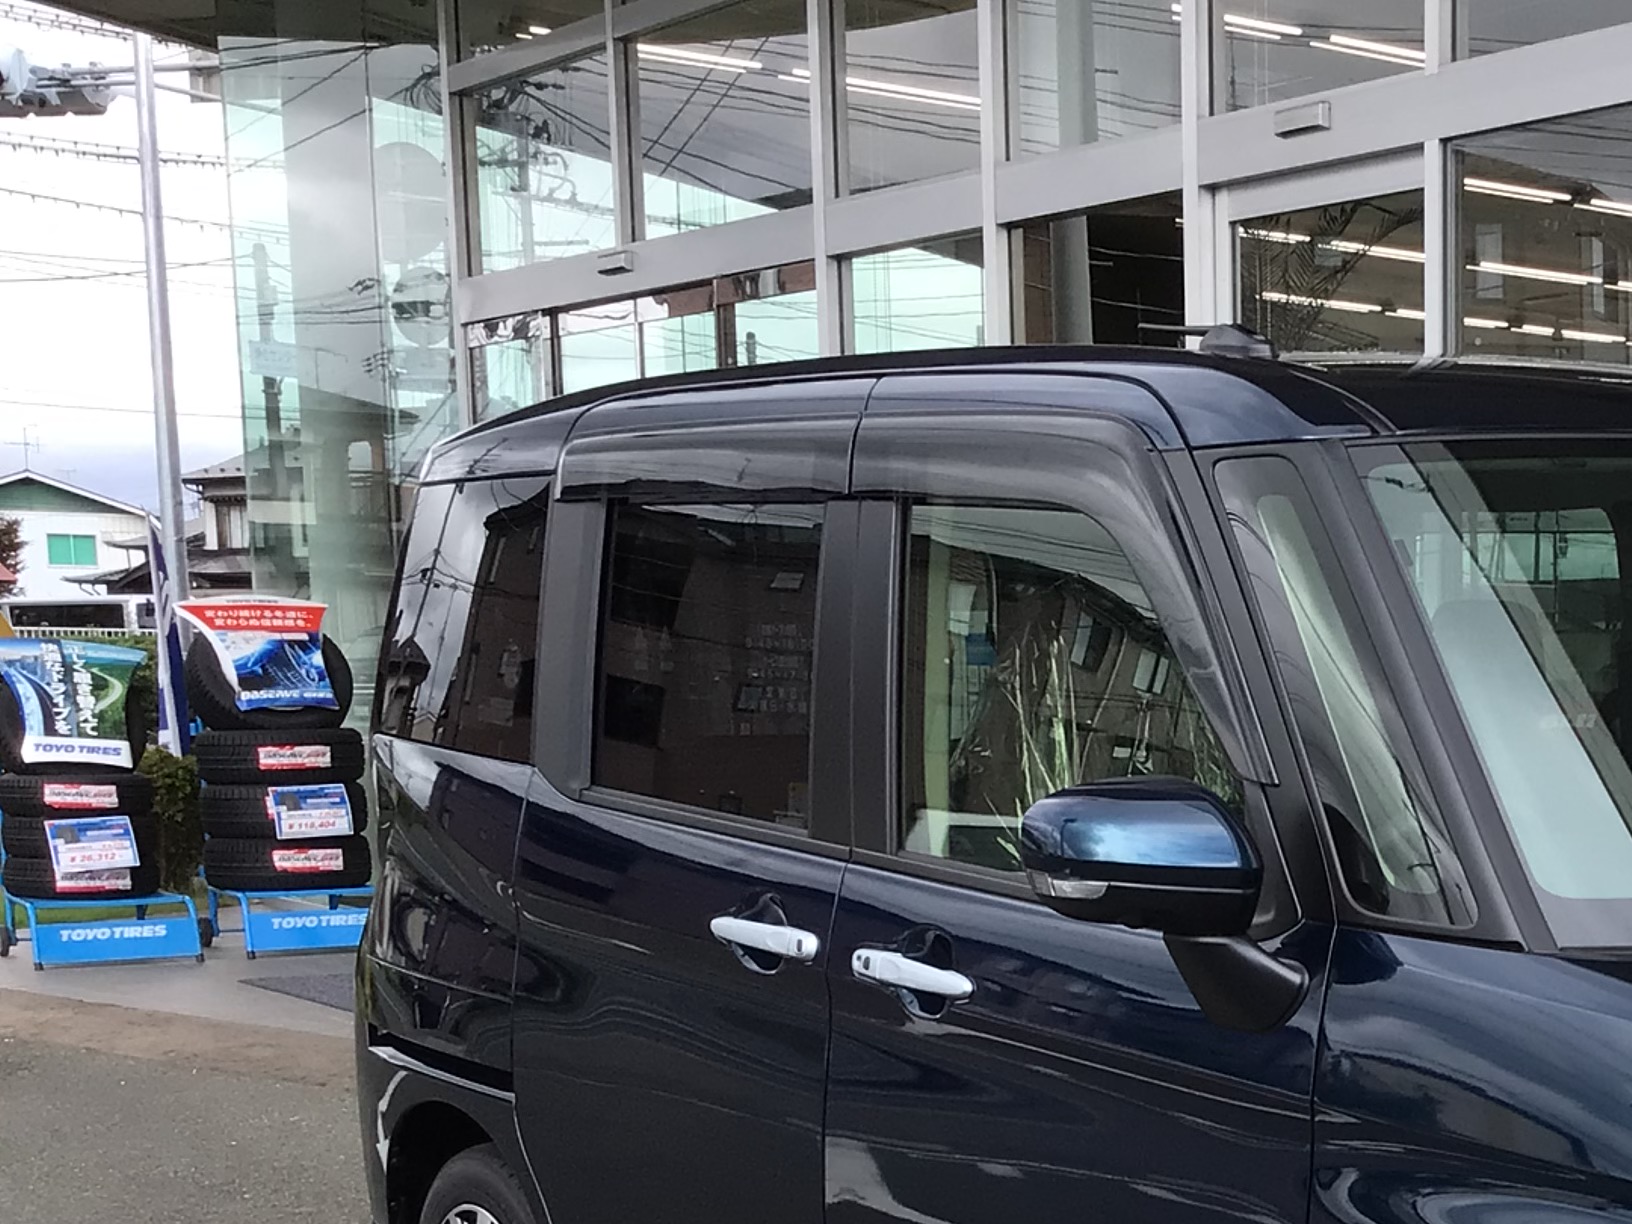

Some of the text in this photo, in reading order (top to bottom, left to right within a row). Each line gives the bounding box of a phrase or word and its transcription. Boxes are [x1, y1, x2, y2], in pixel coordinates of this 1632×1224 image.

[33, 743, 122, 756] TOYO TIRES
[272, 913, 367, 929] TOYO TIRES
[60, 924, 167, 942] TOYO TIRES
